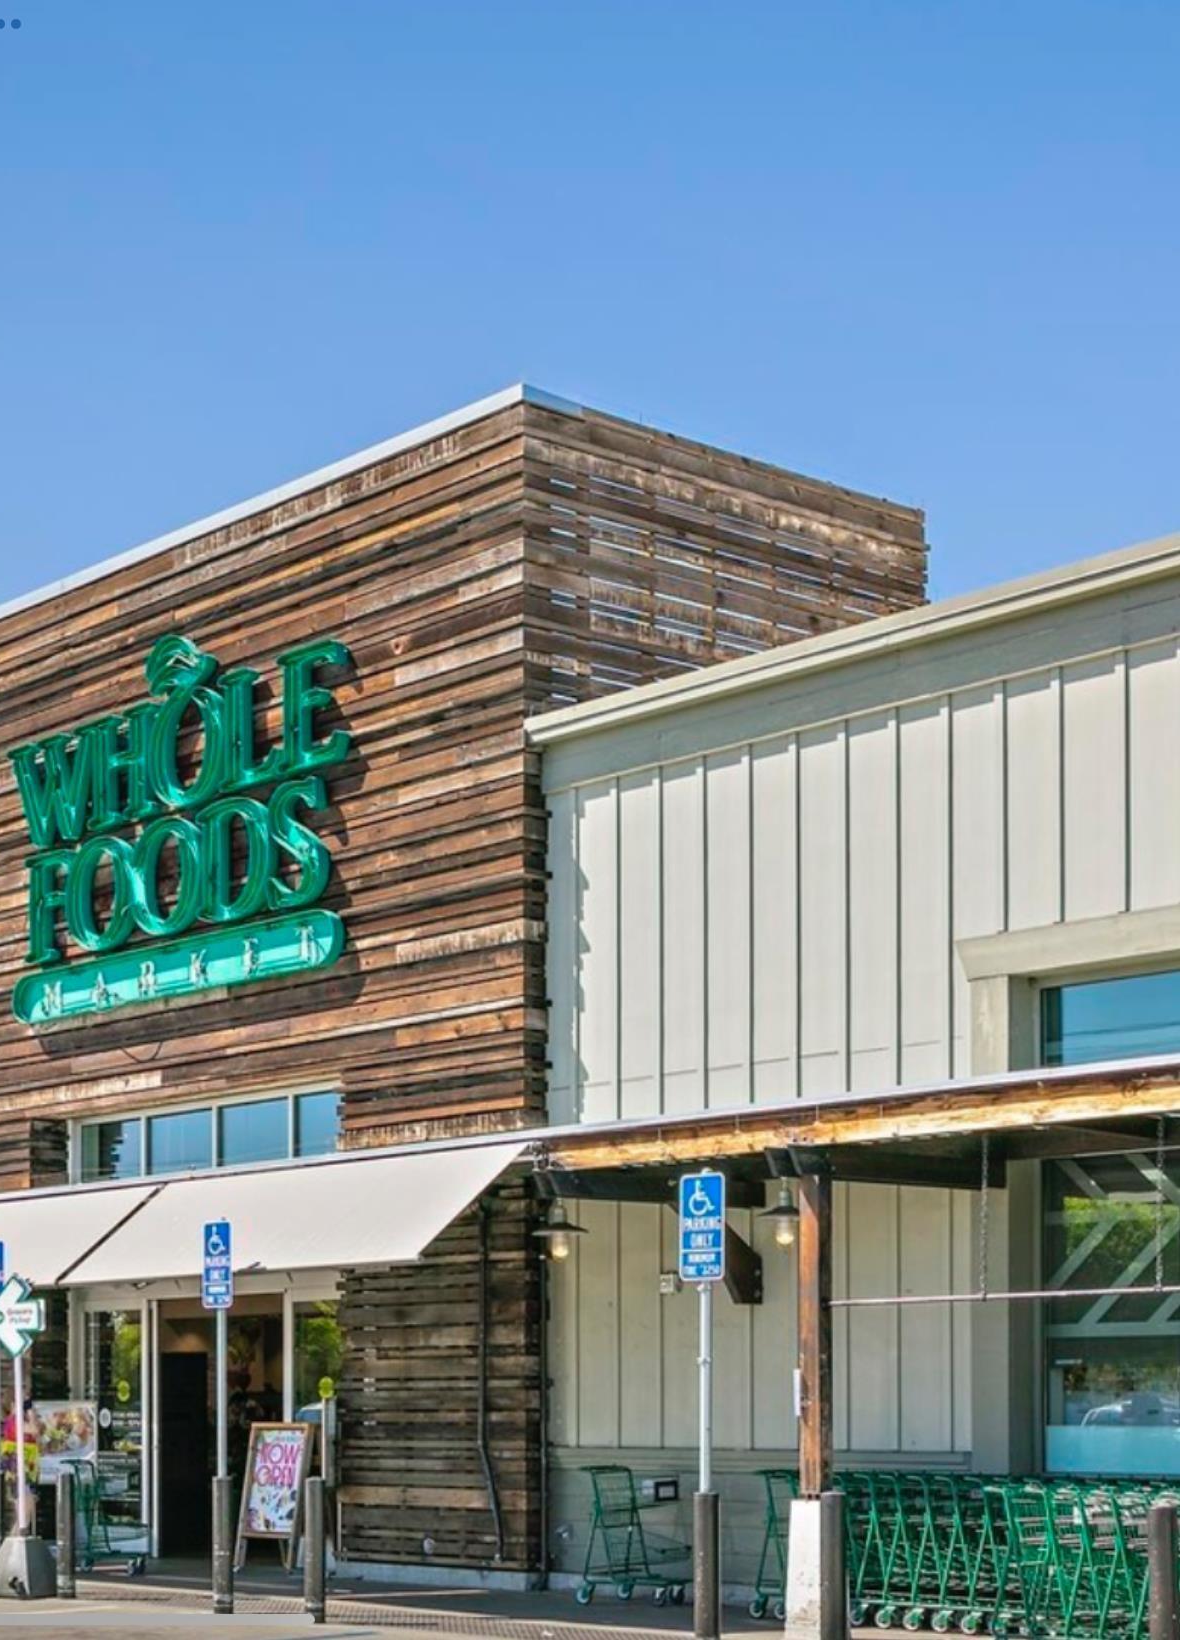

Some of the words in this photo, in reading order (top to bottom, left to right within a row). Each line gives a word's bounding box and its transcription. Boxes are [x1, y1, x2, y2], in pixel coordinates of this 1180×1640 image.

[7, 635, 354, 848] WHOLE
[24, 776, 333, 964] FOODS
[39, 924, 320, 1019] MARKET
[683, 1217, 721, 1231] PARKING
[691, 1233, 714, 1248] ONLY
[260, 1443, 300, 1465] NOW
[257, 1464, 294, 1489] OPEN
